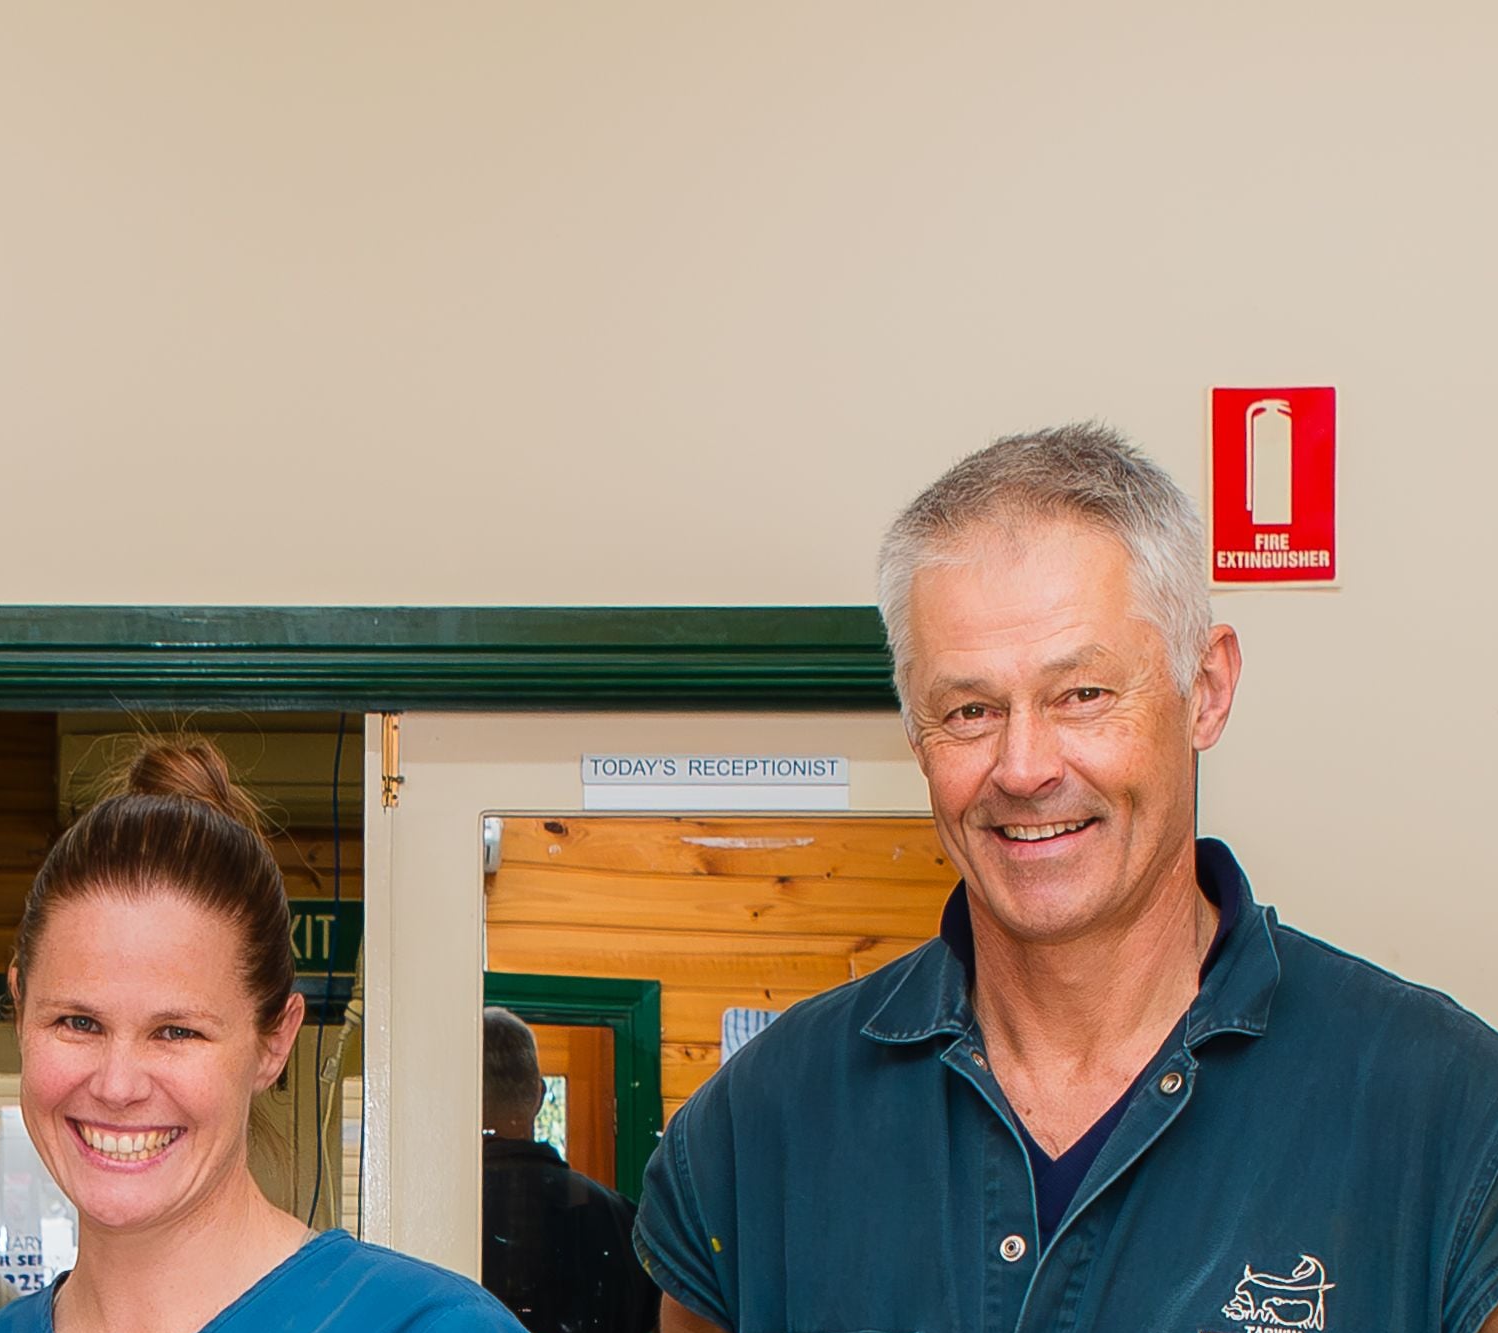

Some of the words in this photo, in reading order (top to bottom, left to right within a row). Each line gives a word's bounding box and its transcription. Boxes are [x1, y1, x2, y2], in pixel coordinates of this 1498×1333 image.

[1255, 533, 1289, 550] FIRE
[1217, 551, 1330, 568] EXTINGUISHER
[591, 759, 676, 776] TODAY'S
[689, 760, 839, 777] RECEPTIONIST
